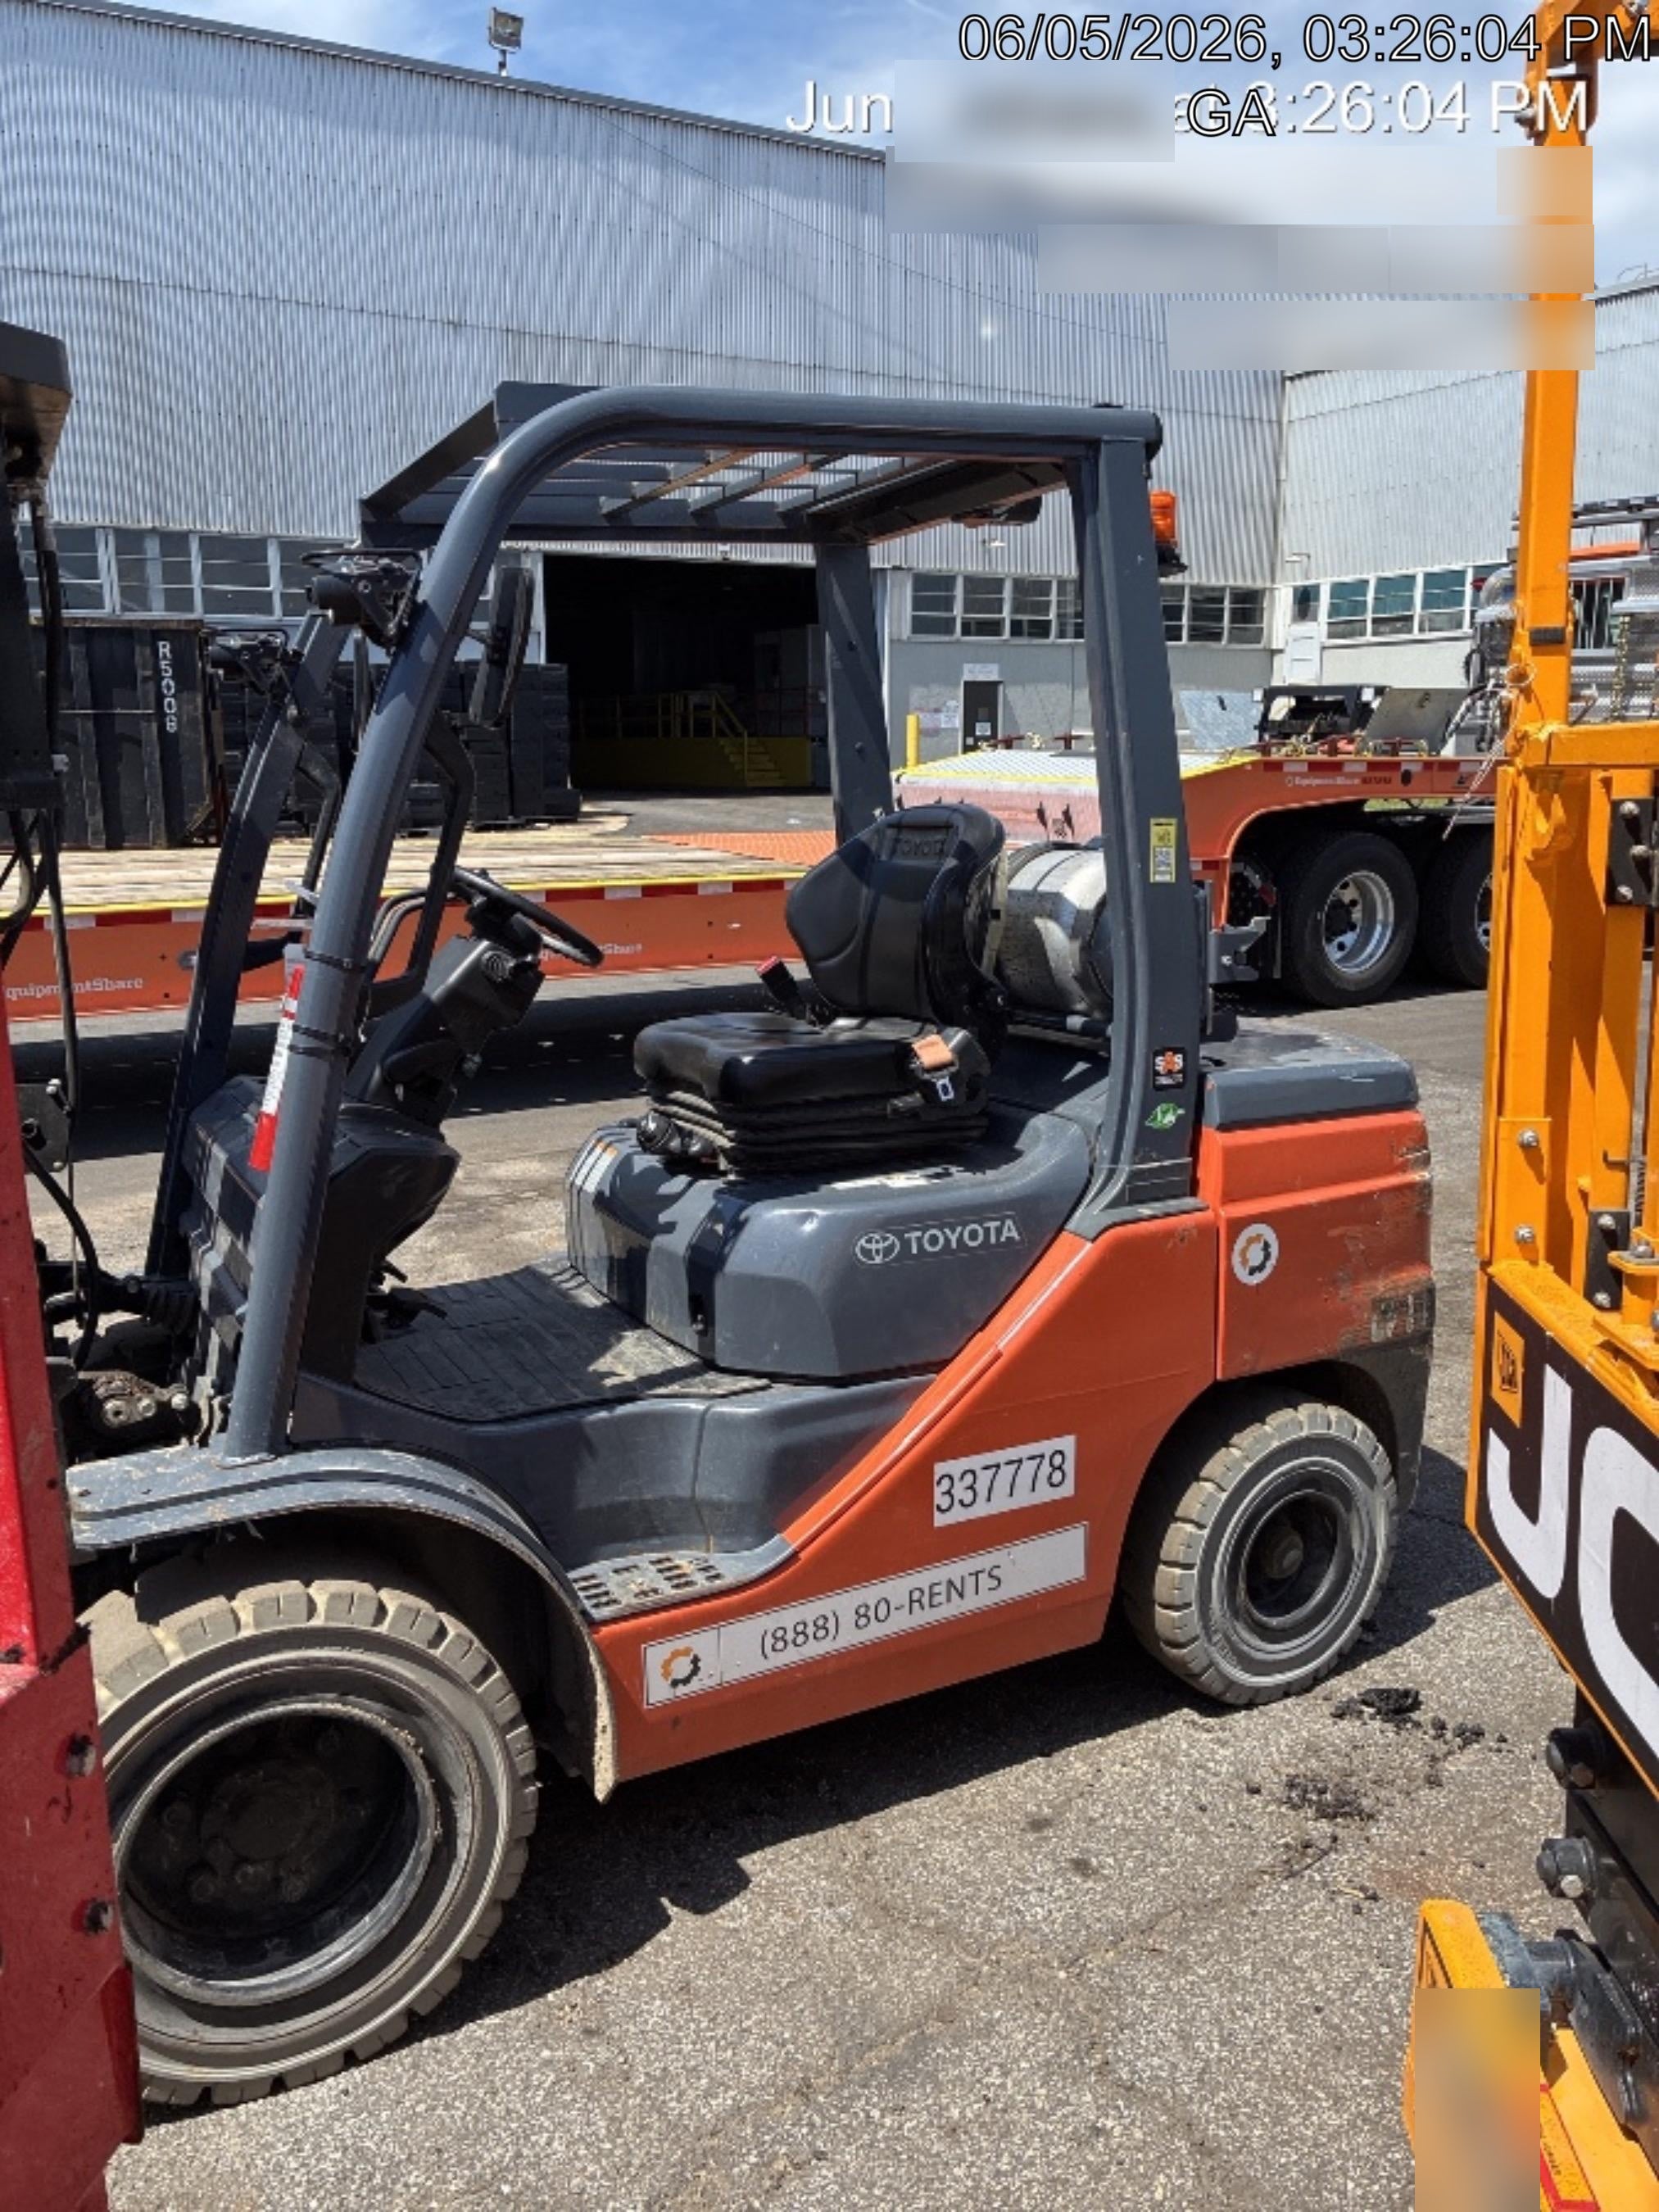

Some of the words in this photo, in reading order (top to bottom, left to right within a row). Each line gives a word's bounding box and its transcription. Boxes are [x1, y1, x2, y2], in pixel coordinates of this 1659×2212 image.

[6, 977, 144, 1001] quipmntShare
[904, 1218, 1021, 1254] TOYOTA
[936, 1449, 1067, 1514] 337778
[760, 1610, 840, 1659] (888)
[854, 1565, 1003, 1630] 80-RENTS
